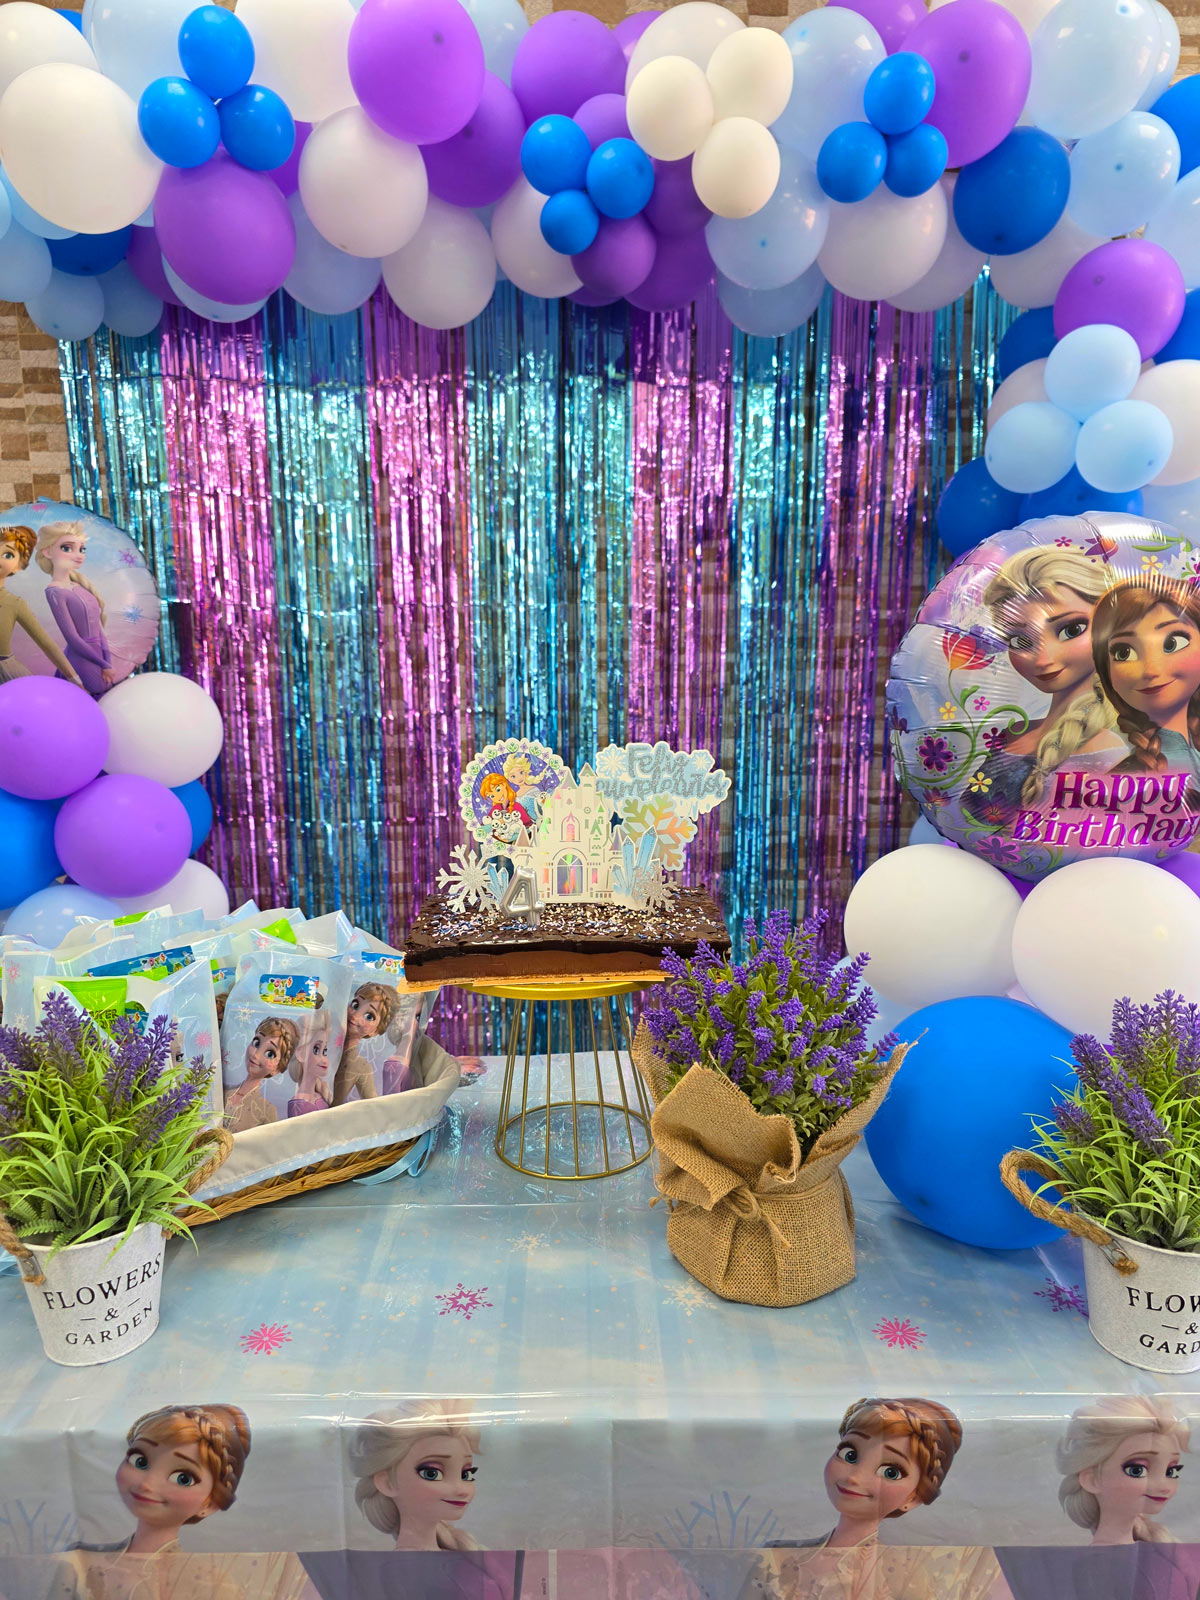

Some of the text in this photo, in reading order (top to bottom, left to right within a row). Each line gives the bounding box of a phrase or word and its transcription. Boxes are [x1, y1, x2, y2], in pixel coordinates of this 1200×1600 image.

[629, 745, 689, 785] Feliz
[1051, 771, 1191, 814] Happy
[1011, 810, 1200, 848] Birthday
[501, 866, 545, 926] 4
[42, 1251, 162, 1311] FLOWERS
[65, 1300, 152, 1345] GARDEN
[104, 1307, 120, 1322] &
[1184, 1322, 1200, 1335] &
